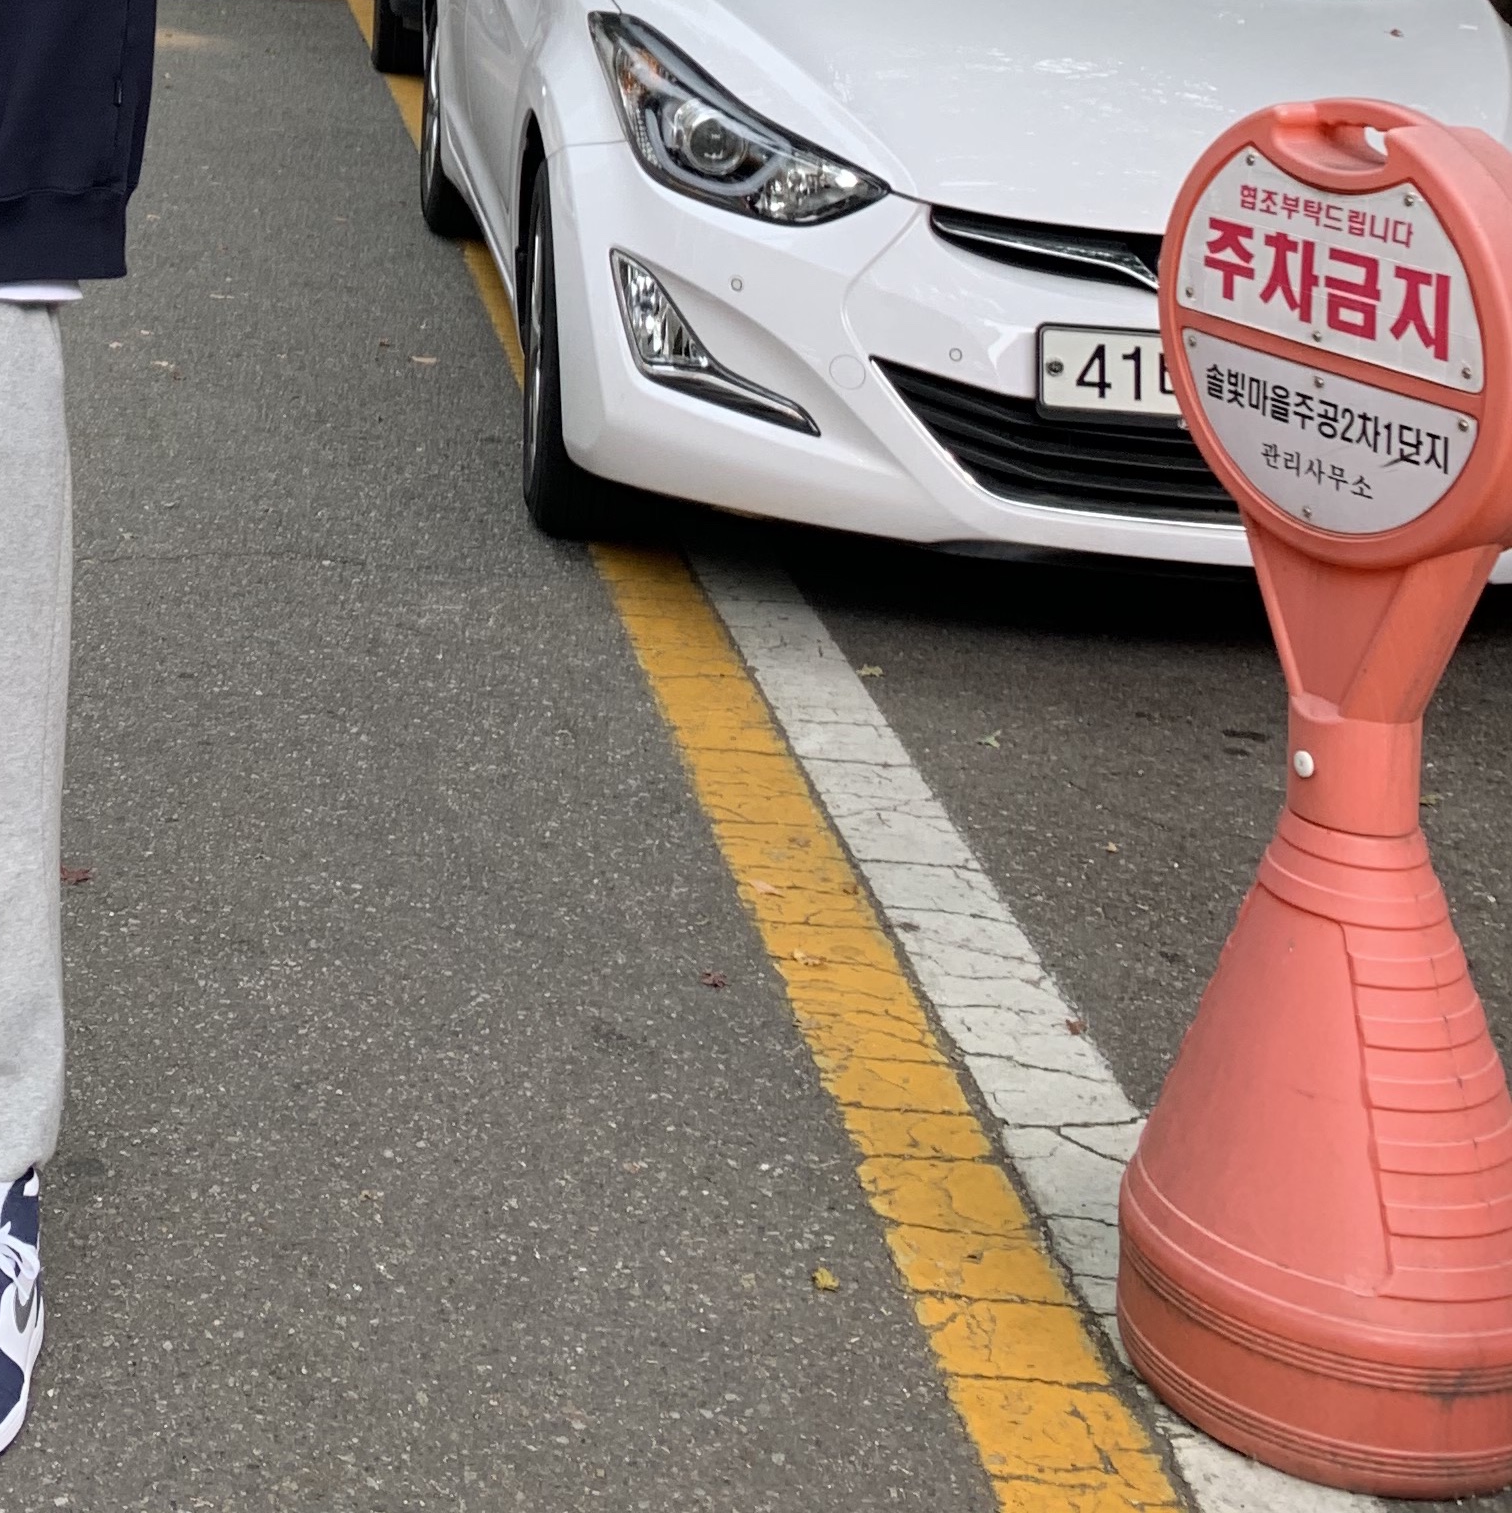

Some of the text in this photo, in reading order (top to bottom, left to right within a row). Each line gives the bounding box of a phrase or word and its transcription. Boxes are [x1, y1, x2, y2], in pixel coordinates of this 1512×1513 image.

[1239, 184, 1414, 249] 협조부탁드립니다
[1204, 217, 1451, 363] 주차금지
[1206, 363, 1450, 475] 솔빛마을주공2차1단지
[1261, 442, 1373, 499] 관리사무소
